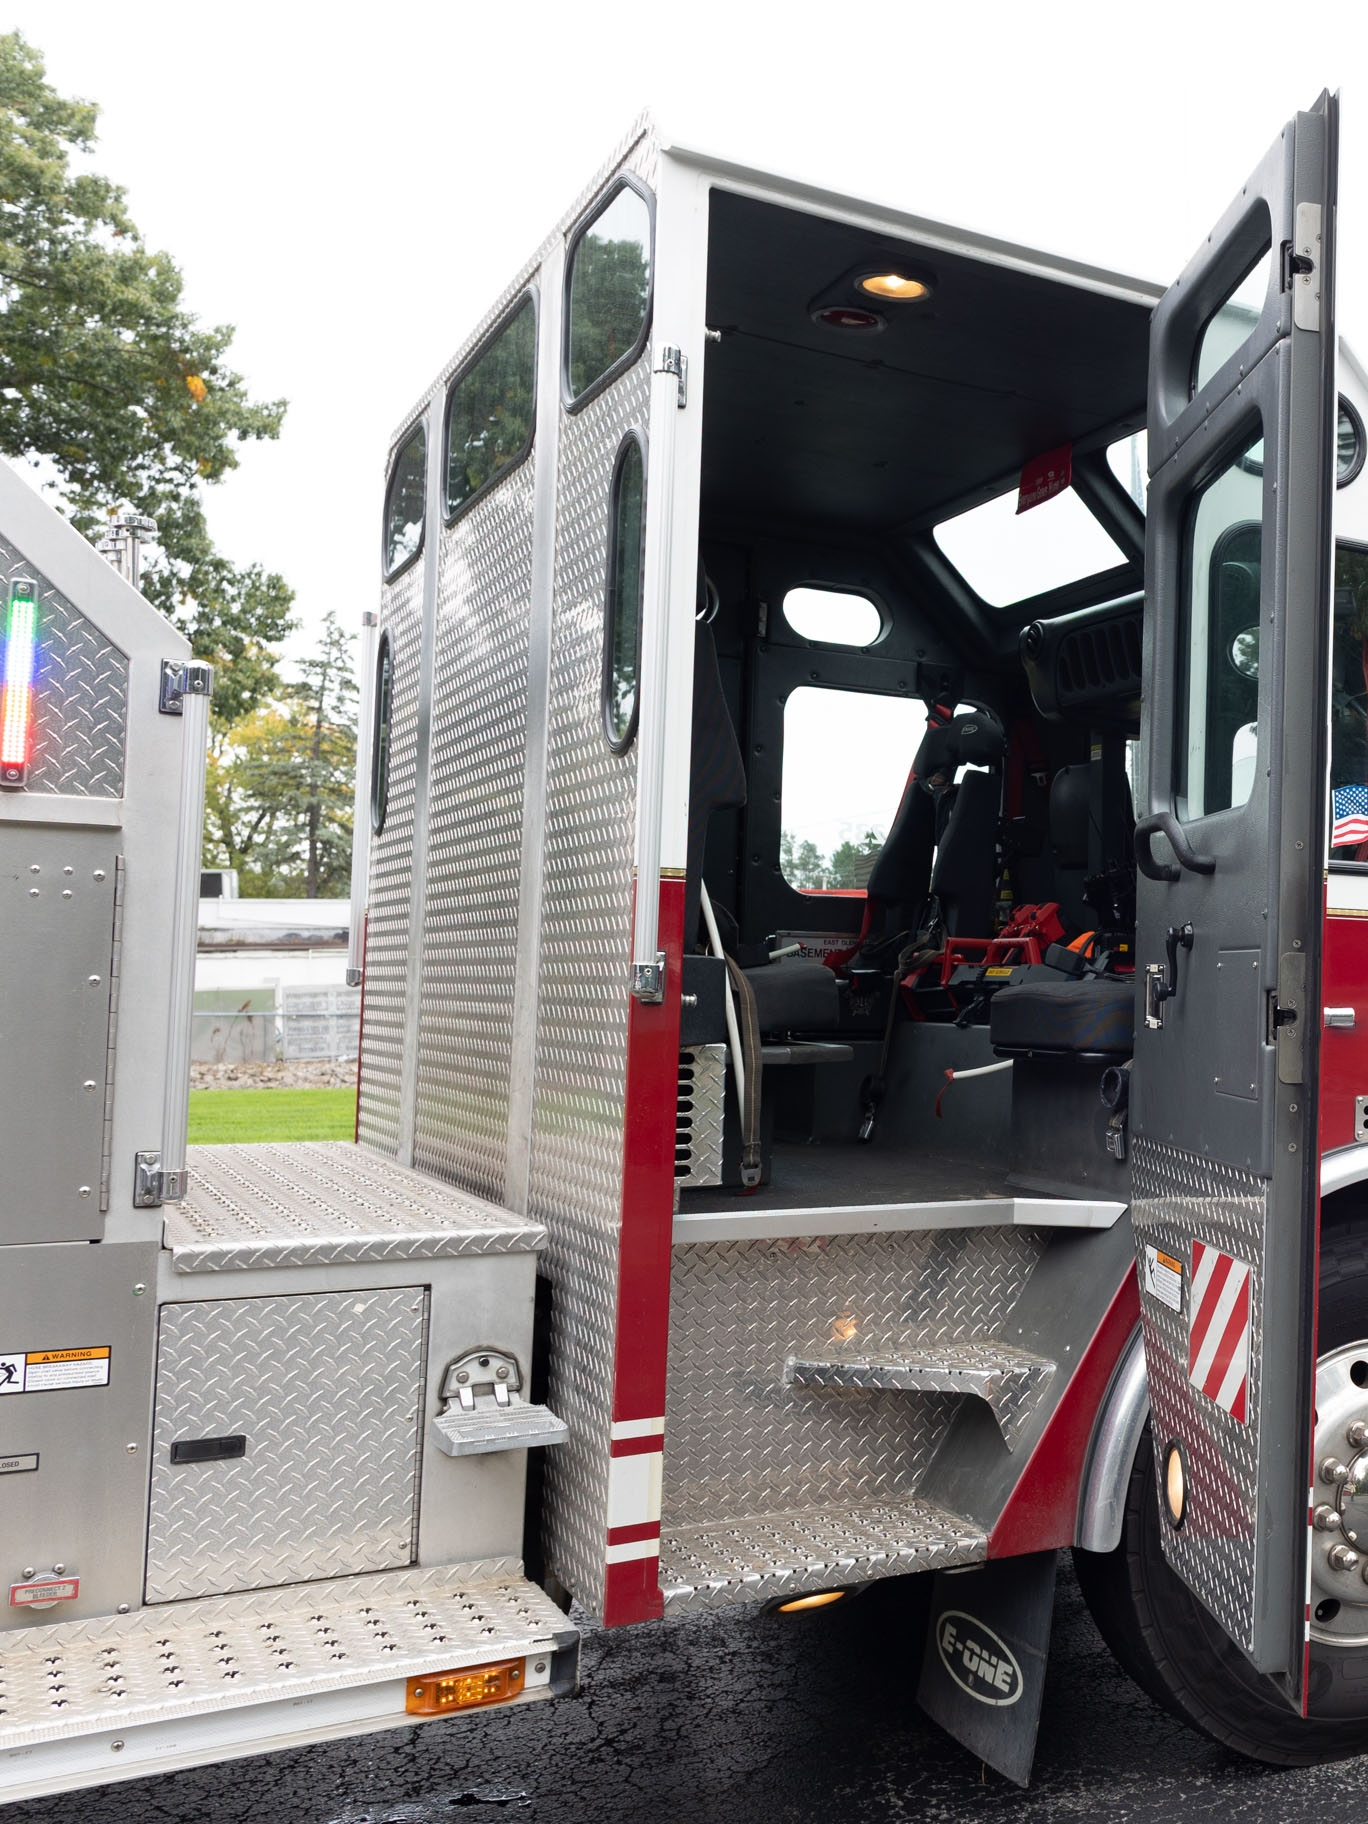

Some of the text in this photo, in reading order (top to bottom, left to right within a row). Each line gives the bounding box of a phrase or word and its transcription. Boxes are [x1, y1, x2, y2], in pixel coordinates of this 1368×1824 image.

[52, 1350, 92, 1360] WARNING
[0, 1461, 20, 1469] OSED
[942, 1622, 1013, 1694] E-ONE
